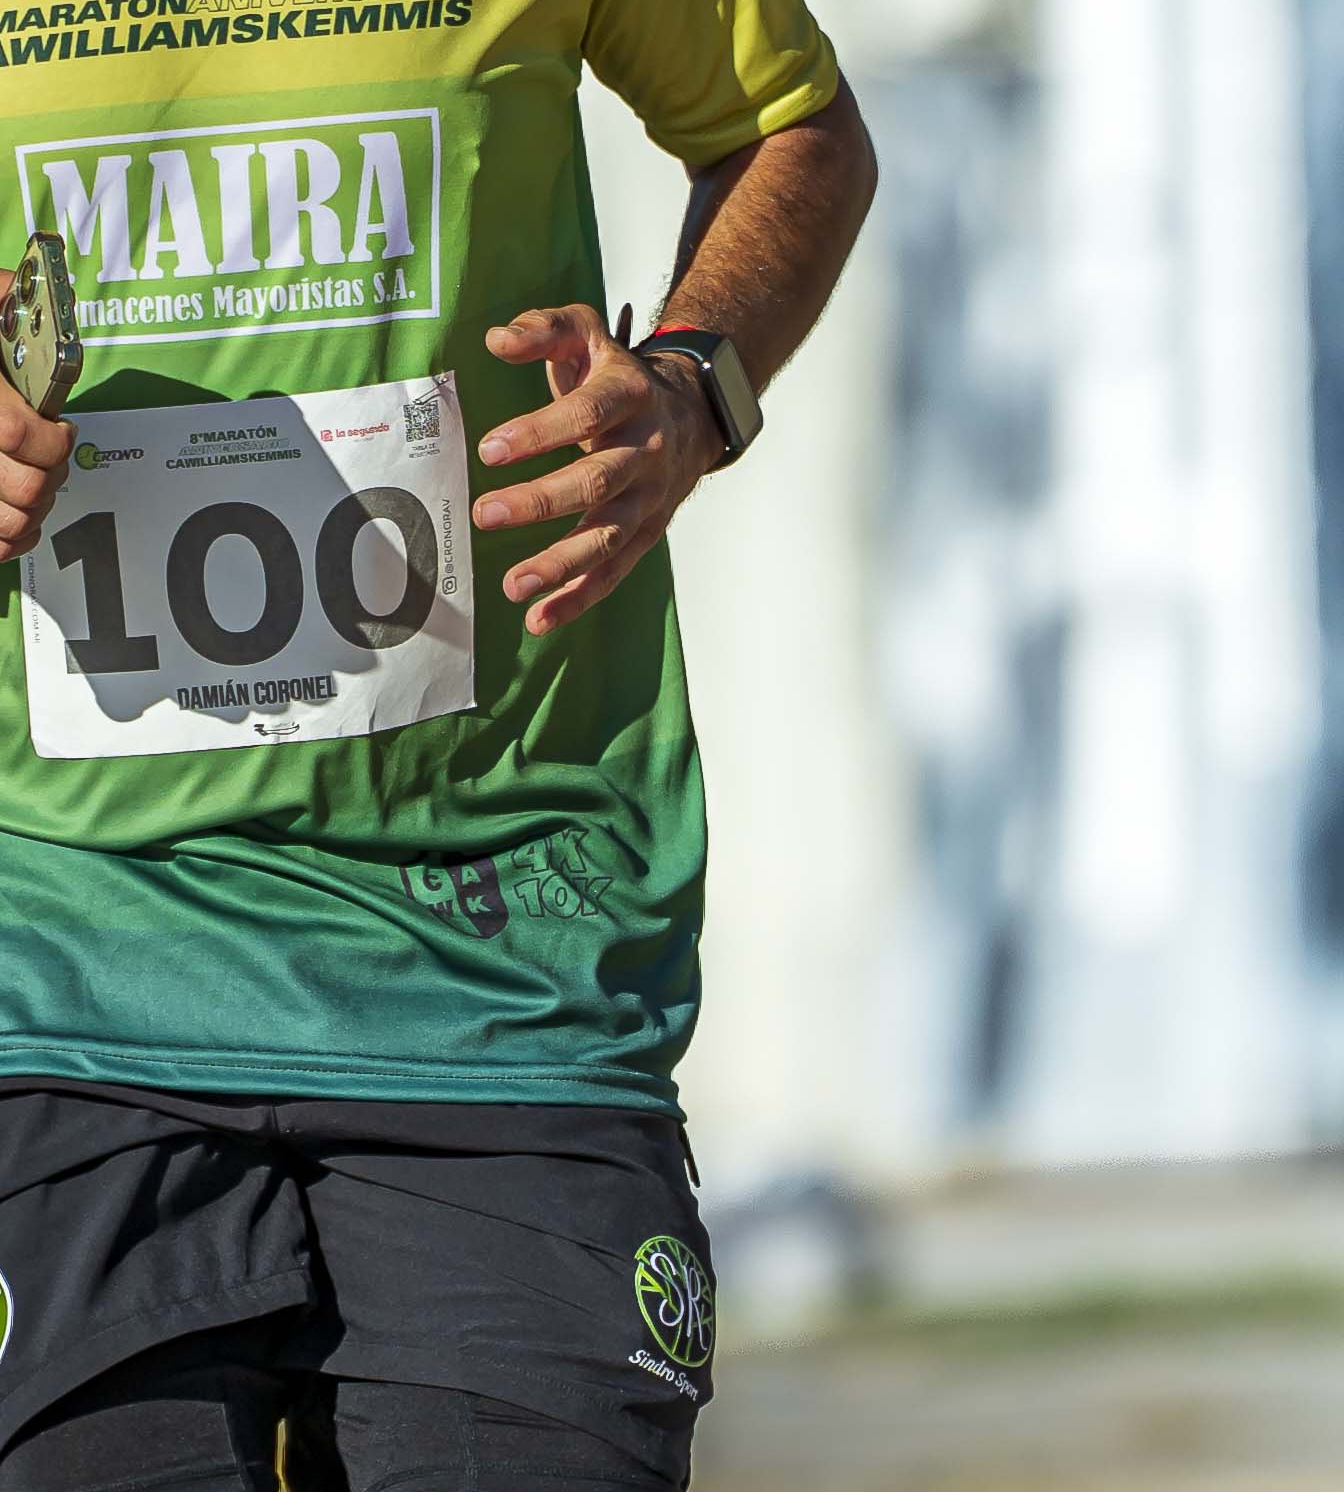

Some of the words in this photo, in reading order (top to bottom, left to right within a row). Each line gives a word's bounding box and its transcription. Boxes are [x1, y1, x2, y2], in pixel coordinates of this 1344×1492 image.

[42, 131, 415, 284] MAIRA
[74, 297, 203, 328] macenes
[213, 278, 364, 319] Mayoristas
[373, 269, 416, 304] S.A.
[166, 448, 302, 470] CAWILLIAMSKEMMIS
[50, 486, 439, 675] 100
[177, 679, 250, 711] DAMIÁN
[254, 675, 338, 705] CORONEL
[514, 873, 613, 919] 10K
[629, 1349, 675, 1382] Sindro
